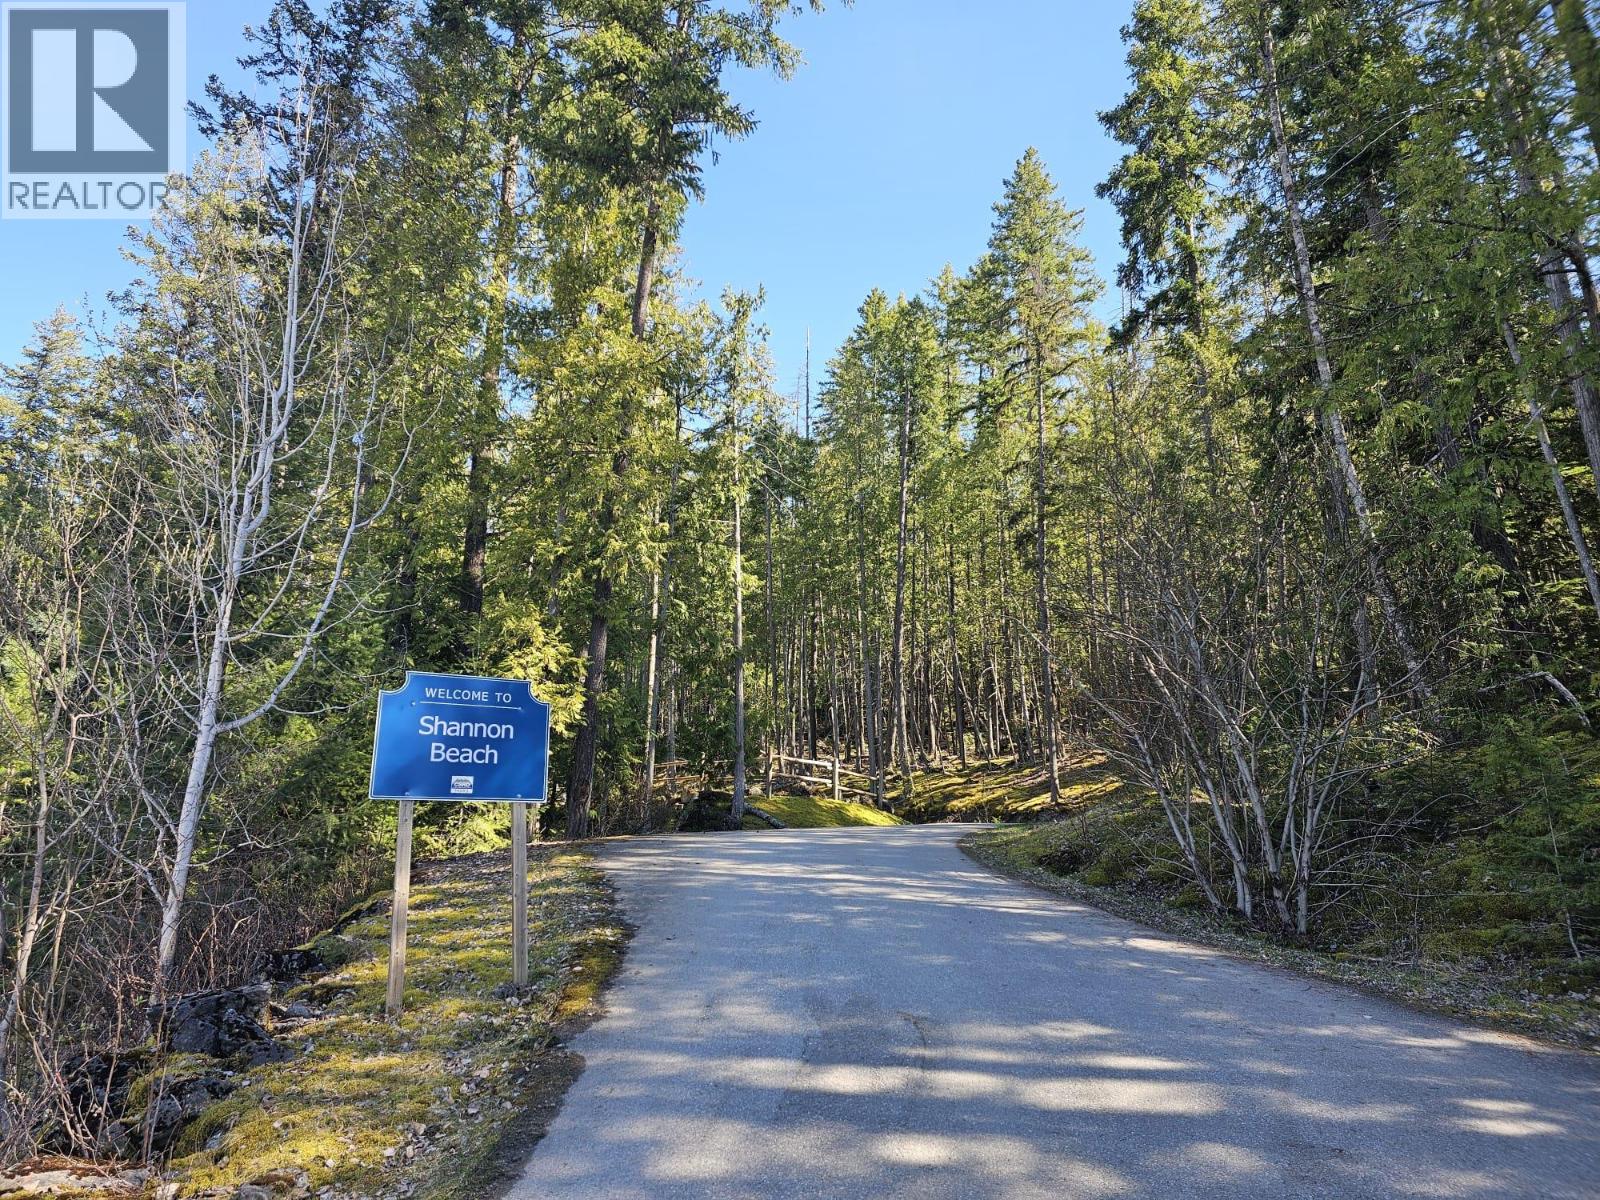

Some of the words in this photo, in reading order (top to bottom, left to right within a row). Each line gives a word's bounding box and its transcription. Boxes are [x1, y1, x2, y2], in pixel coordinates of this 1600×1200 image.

[425, 688, 489, 702] WELCOME
[495, 692, 512, 703] TO
[418, 715, 514, 739] Shannon
[430, 742, 498, 764] Beach
